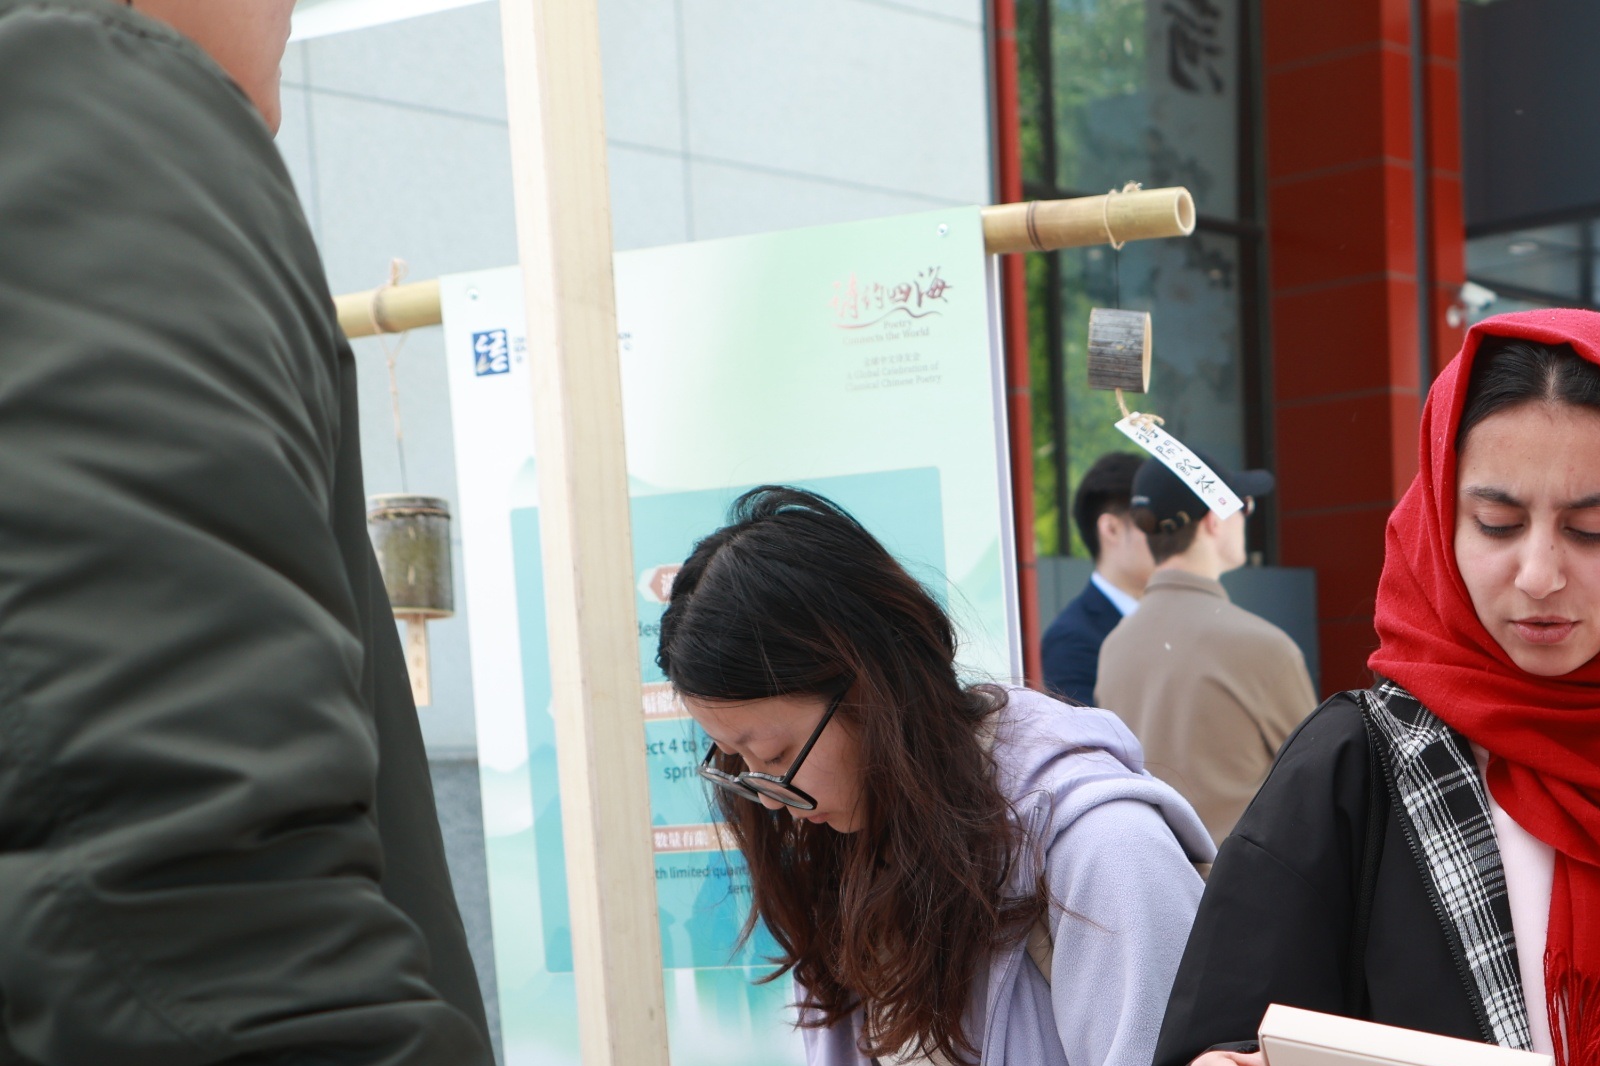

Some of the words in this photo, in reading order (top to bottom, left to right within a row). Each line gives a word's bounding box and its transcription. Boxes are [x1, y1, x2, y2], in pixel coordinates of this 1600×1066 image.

[883, 319, 912, 329] Poetry
[902, 326, 930, 338] World
[916, 373, 942, 385] Poetry
[669, 737, 678, 752] 4
[682, 739, 697, 753] to
[669, 865, 709, 879] limited
